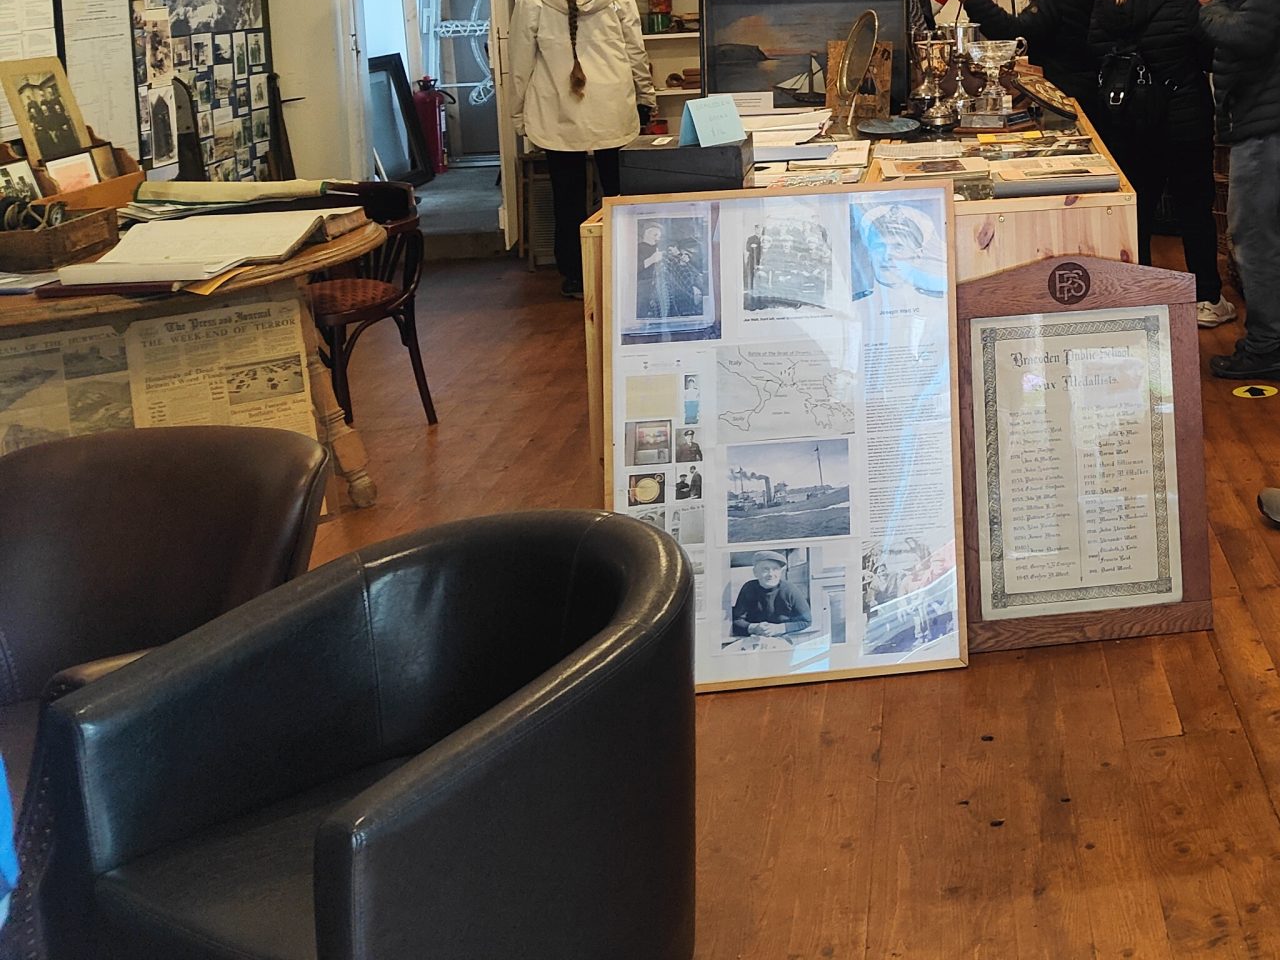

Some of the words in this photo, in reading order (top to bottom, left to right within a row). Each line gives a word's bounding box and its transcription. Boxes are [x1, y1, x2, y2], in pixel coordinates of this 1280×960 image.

[165, 321, 186, 333] The
[189, 318, 216, 330] Press
[219, 316, 232, 325] and
[235, 308, 272, 324] Journal
[255, 318, 296, 331] TERROR
